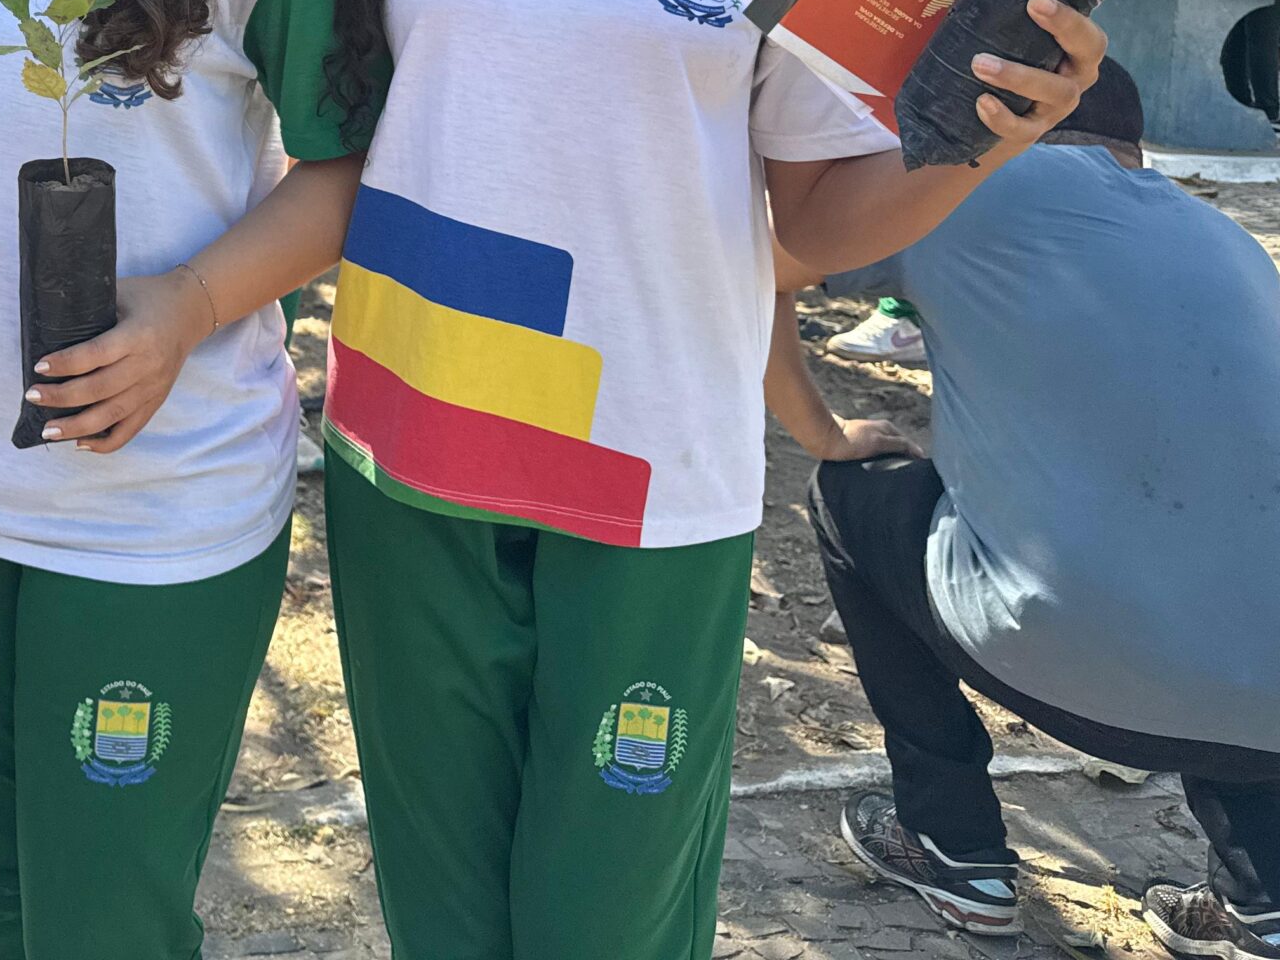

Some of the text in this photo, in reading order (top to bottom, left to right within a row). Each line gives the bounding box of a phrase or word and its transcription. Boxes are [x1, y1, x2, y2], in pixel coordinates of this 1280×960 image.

[854, 10, 887, 34] SECRETARIA
[858, 5, 903, 38] DA DEFESA CIVIL
[913, 20, 922, 28] DA
[100, 680, 125, 695] ESTADO
[126, 680, 137, 688] DO
[623, 681, 646, 697] ESTADO
[646, 681, 657, 689] DO
